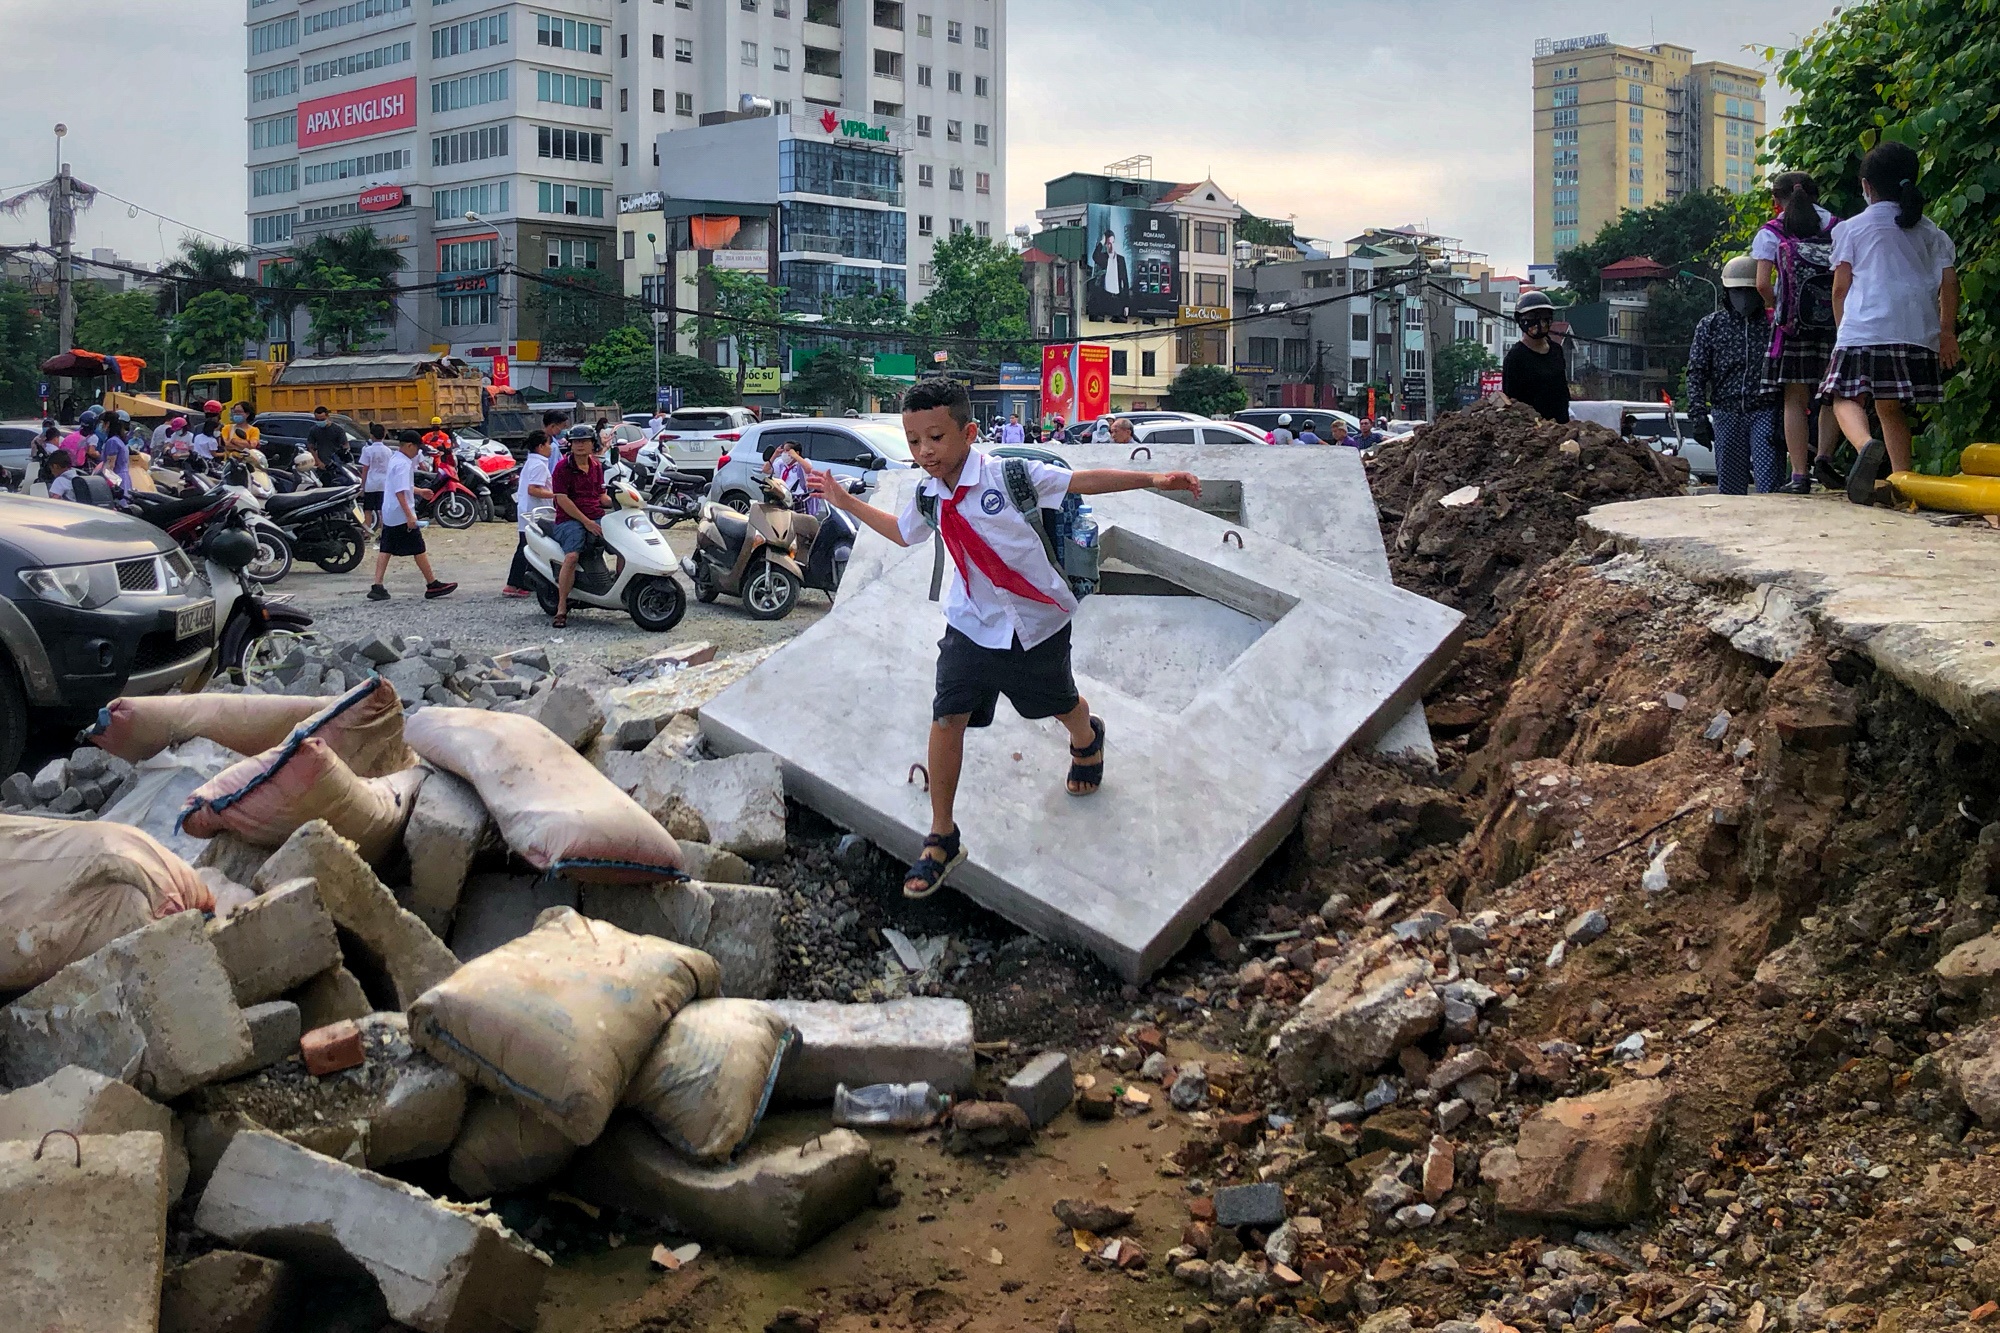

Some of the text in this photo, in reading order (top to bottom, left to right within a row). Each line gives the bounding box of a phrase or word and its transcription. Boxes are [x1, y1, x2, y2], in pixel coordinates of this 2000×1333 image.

[1553, 33, 1607, 51] EXIMBANK
[306, 94, 404, 134] APAX ENGLISH
[841, 119, 890, 142] VPBank
[385, 191, 399, 201] LIFE
[762, 370, 774, 380] SƯ
[41, 384, 47, 395] P
